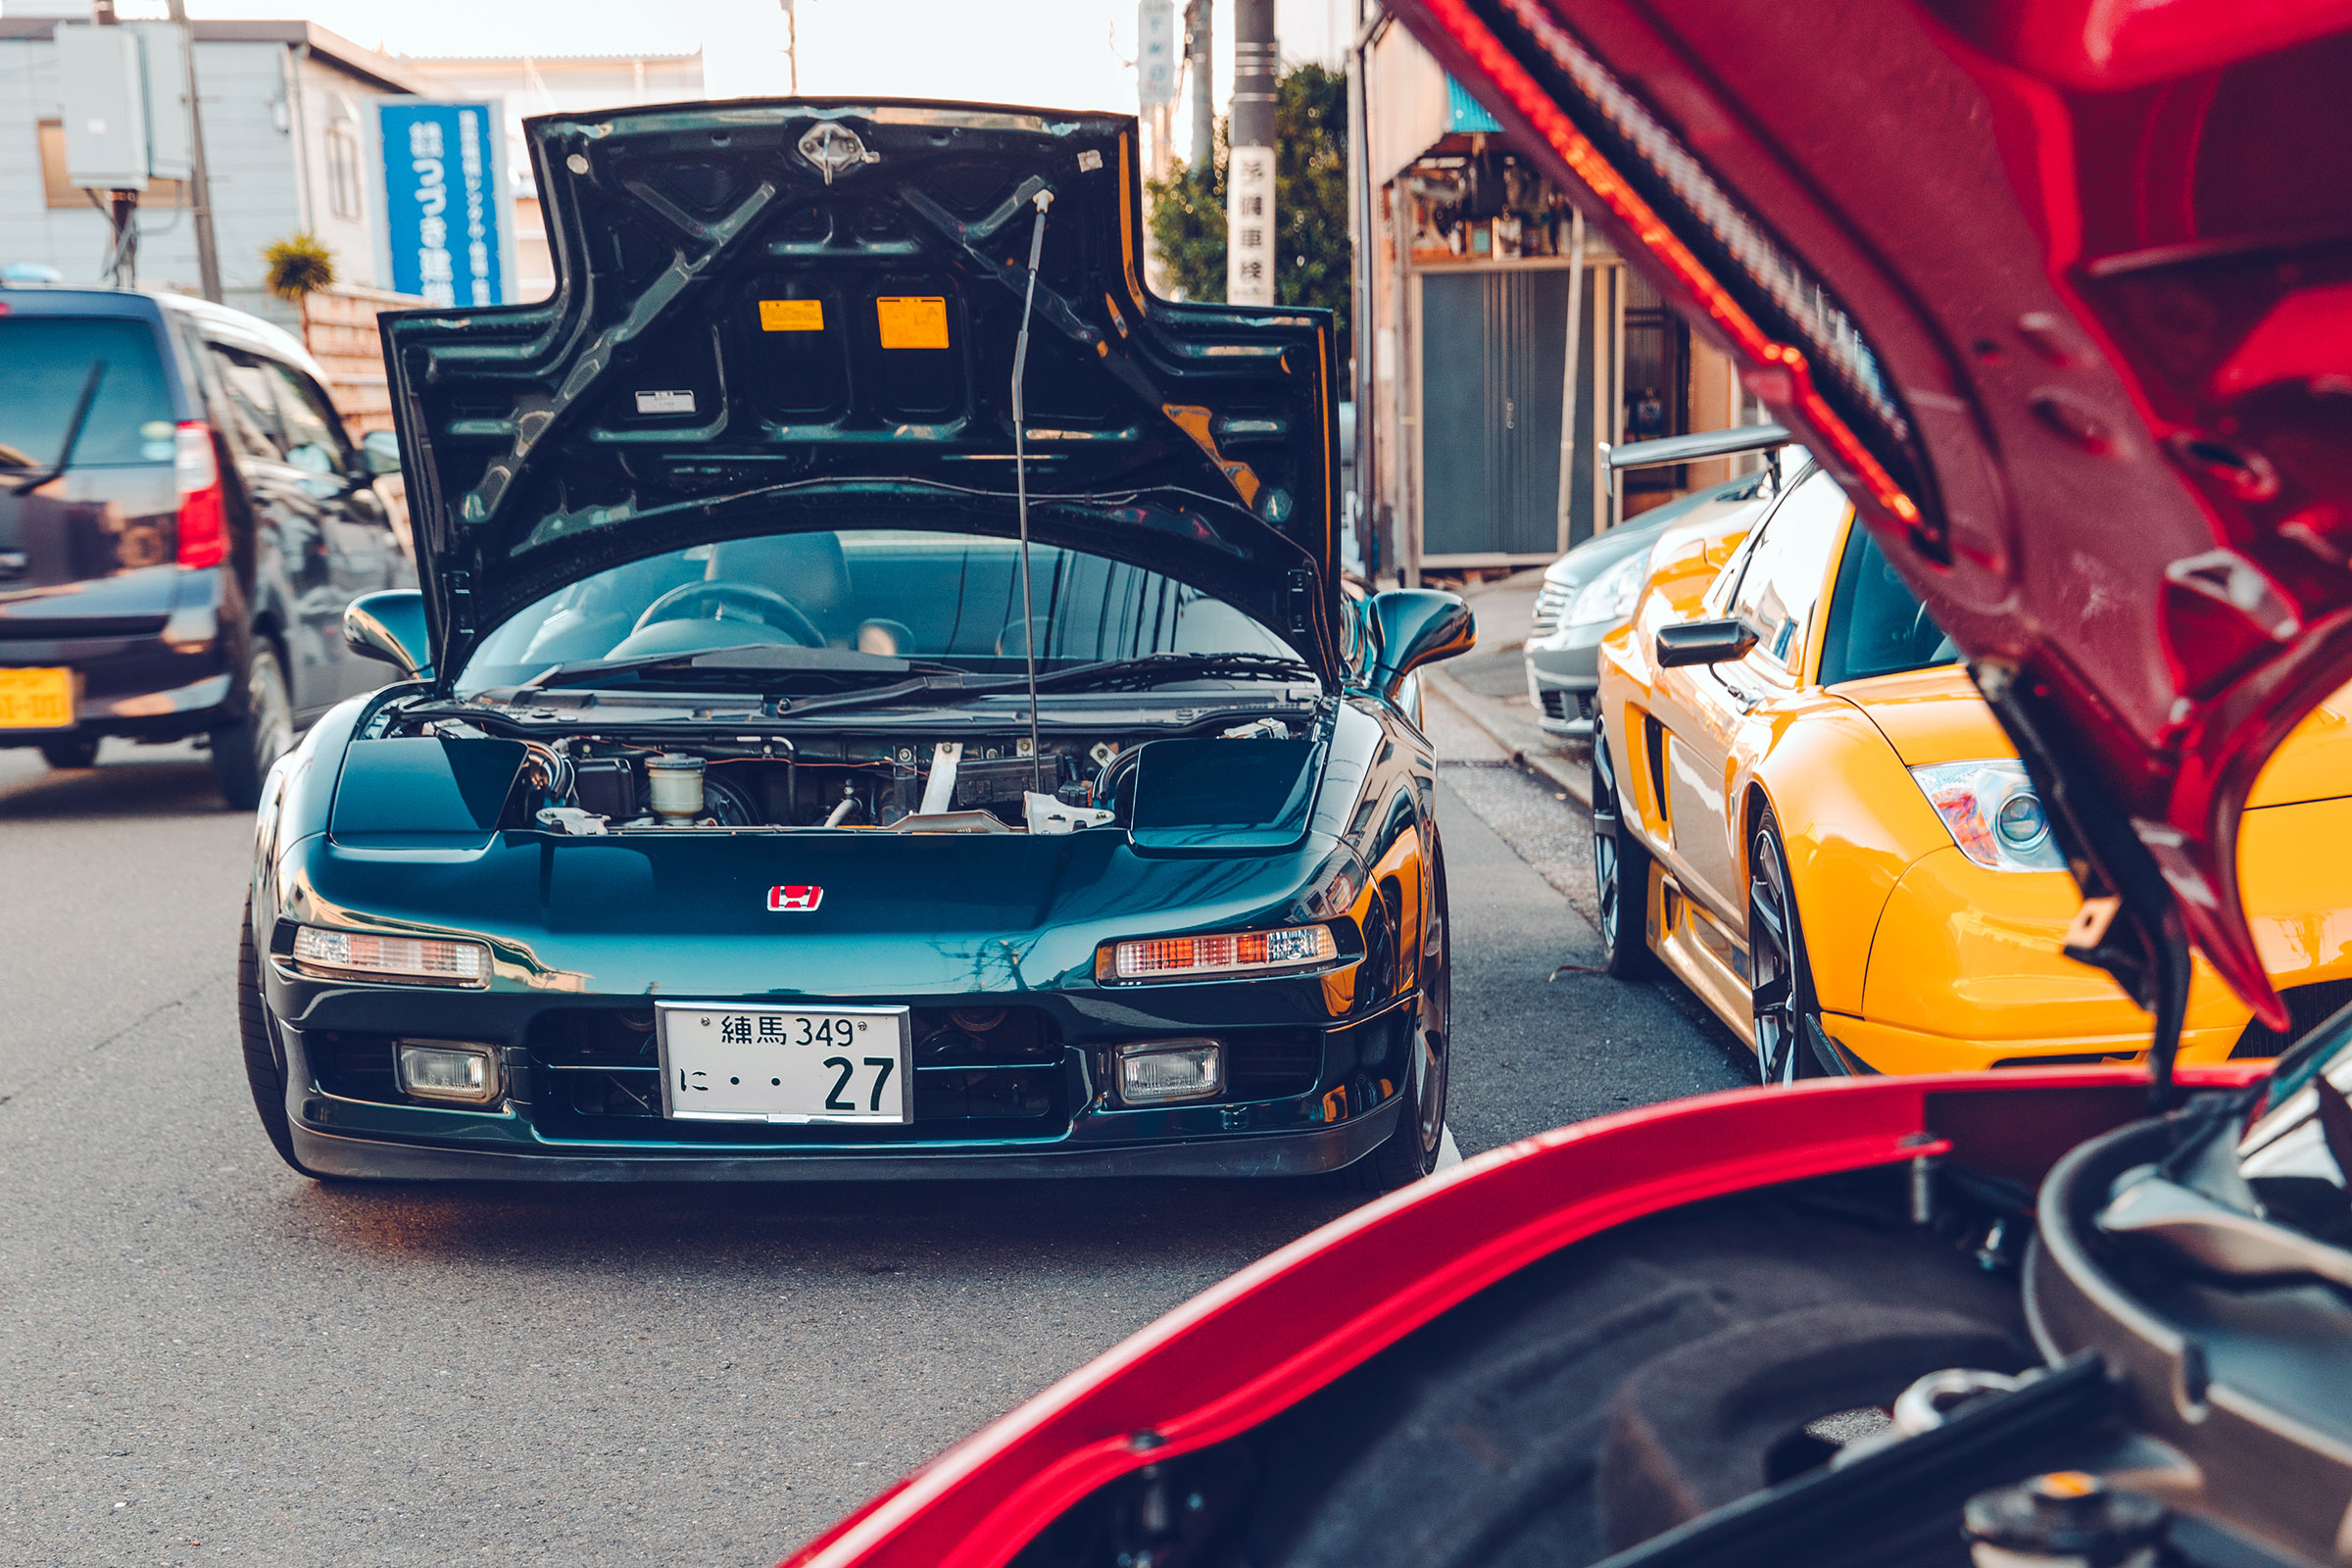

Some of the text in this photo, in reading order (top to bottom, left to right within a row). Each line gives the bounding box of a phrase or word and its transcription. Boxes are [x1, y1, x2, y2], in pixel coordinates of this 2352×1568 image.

[720, 1014, 855, 1048] 練馬 349
[822, 1054, 896, 1112] 27
